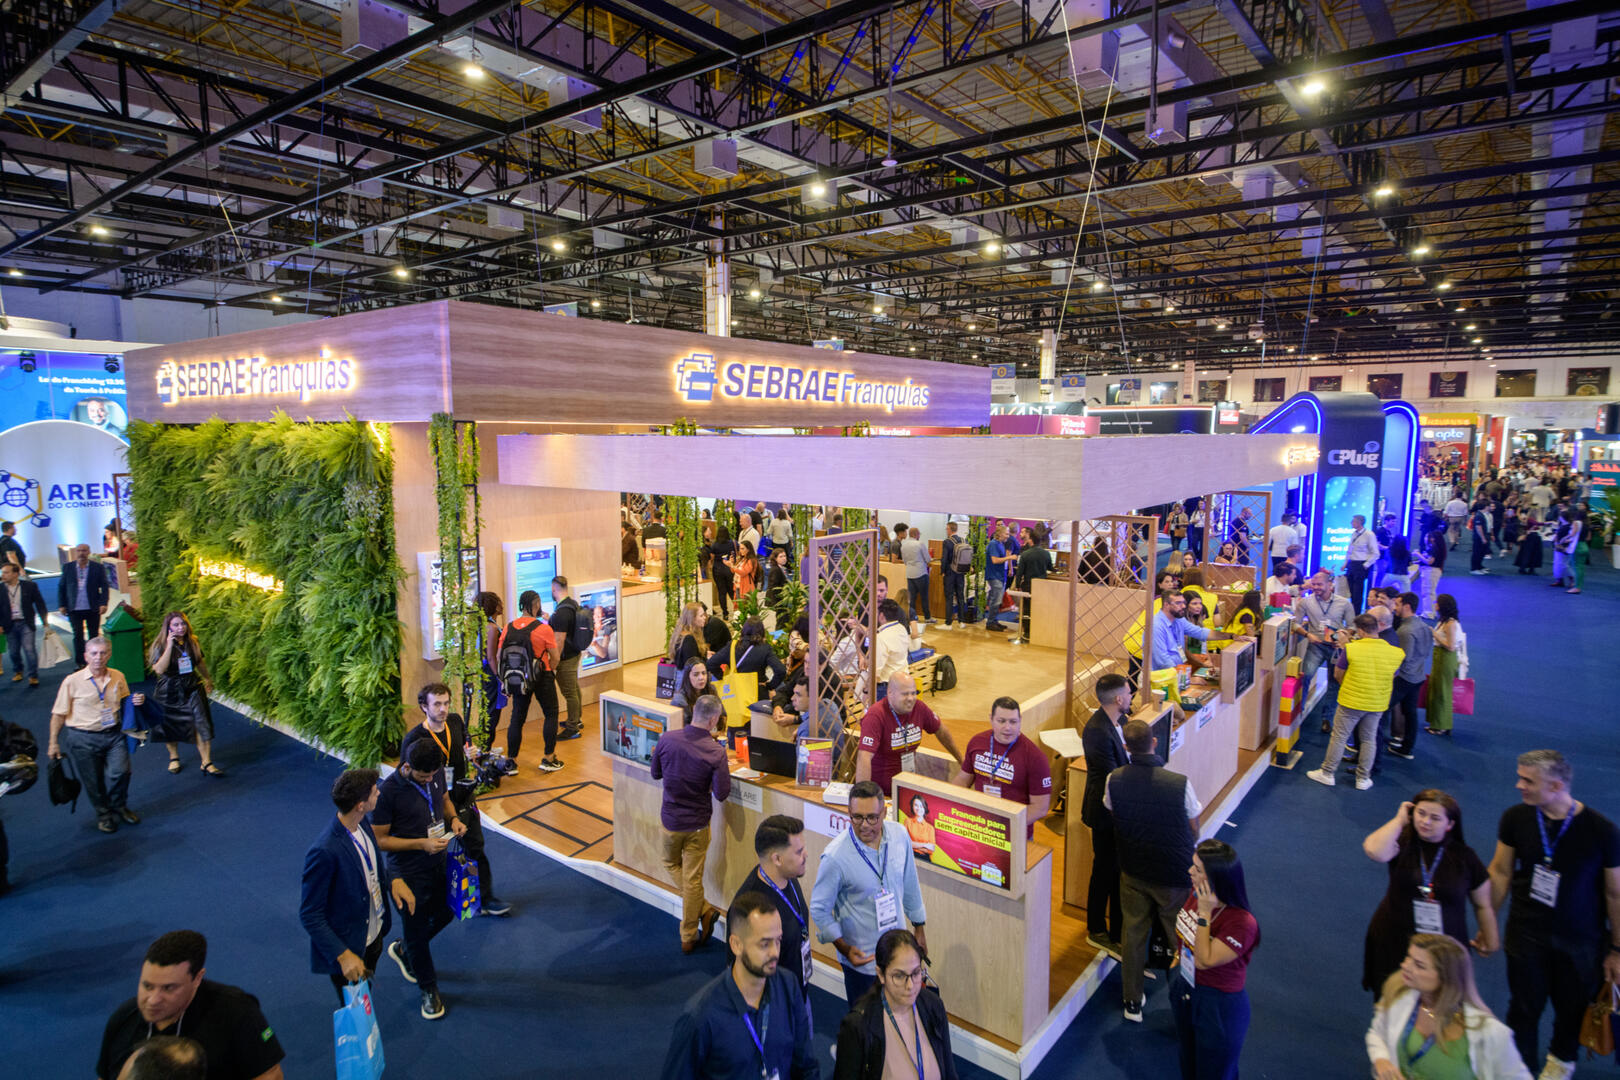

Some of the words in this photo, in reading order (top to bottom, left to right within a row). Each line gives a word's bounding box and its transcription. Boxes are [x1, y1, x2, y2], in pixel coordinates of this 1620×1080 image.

[177, 358, 246, 397] SEBRAE
[250, 349, 350, 400] Franquias
[724, 362, 838, 402] SEBRAE
[841, 373, 930, 411] Franquias
[1328, 449, 1379, 468] CPlug
[951, 807, 986, 824] Franquia
[987, 819, 1006, 831] para
[936, 821, 952, 832] sem
[953, 827, 981, 841] capital
[981, 835, 1006, 848] inicial
